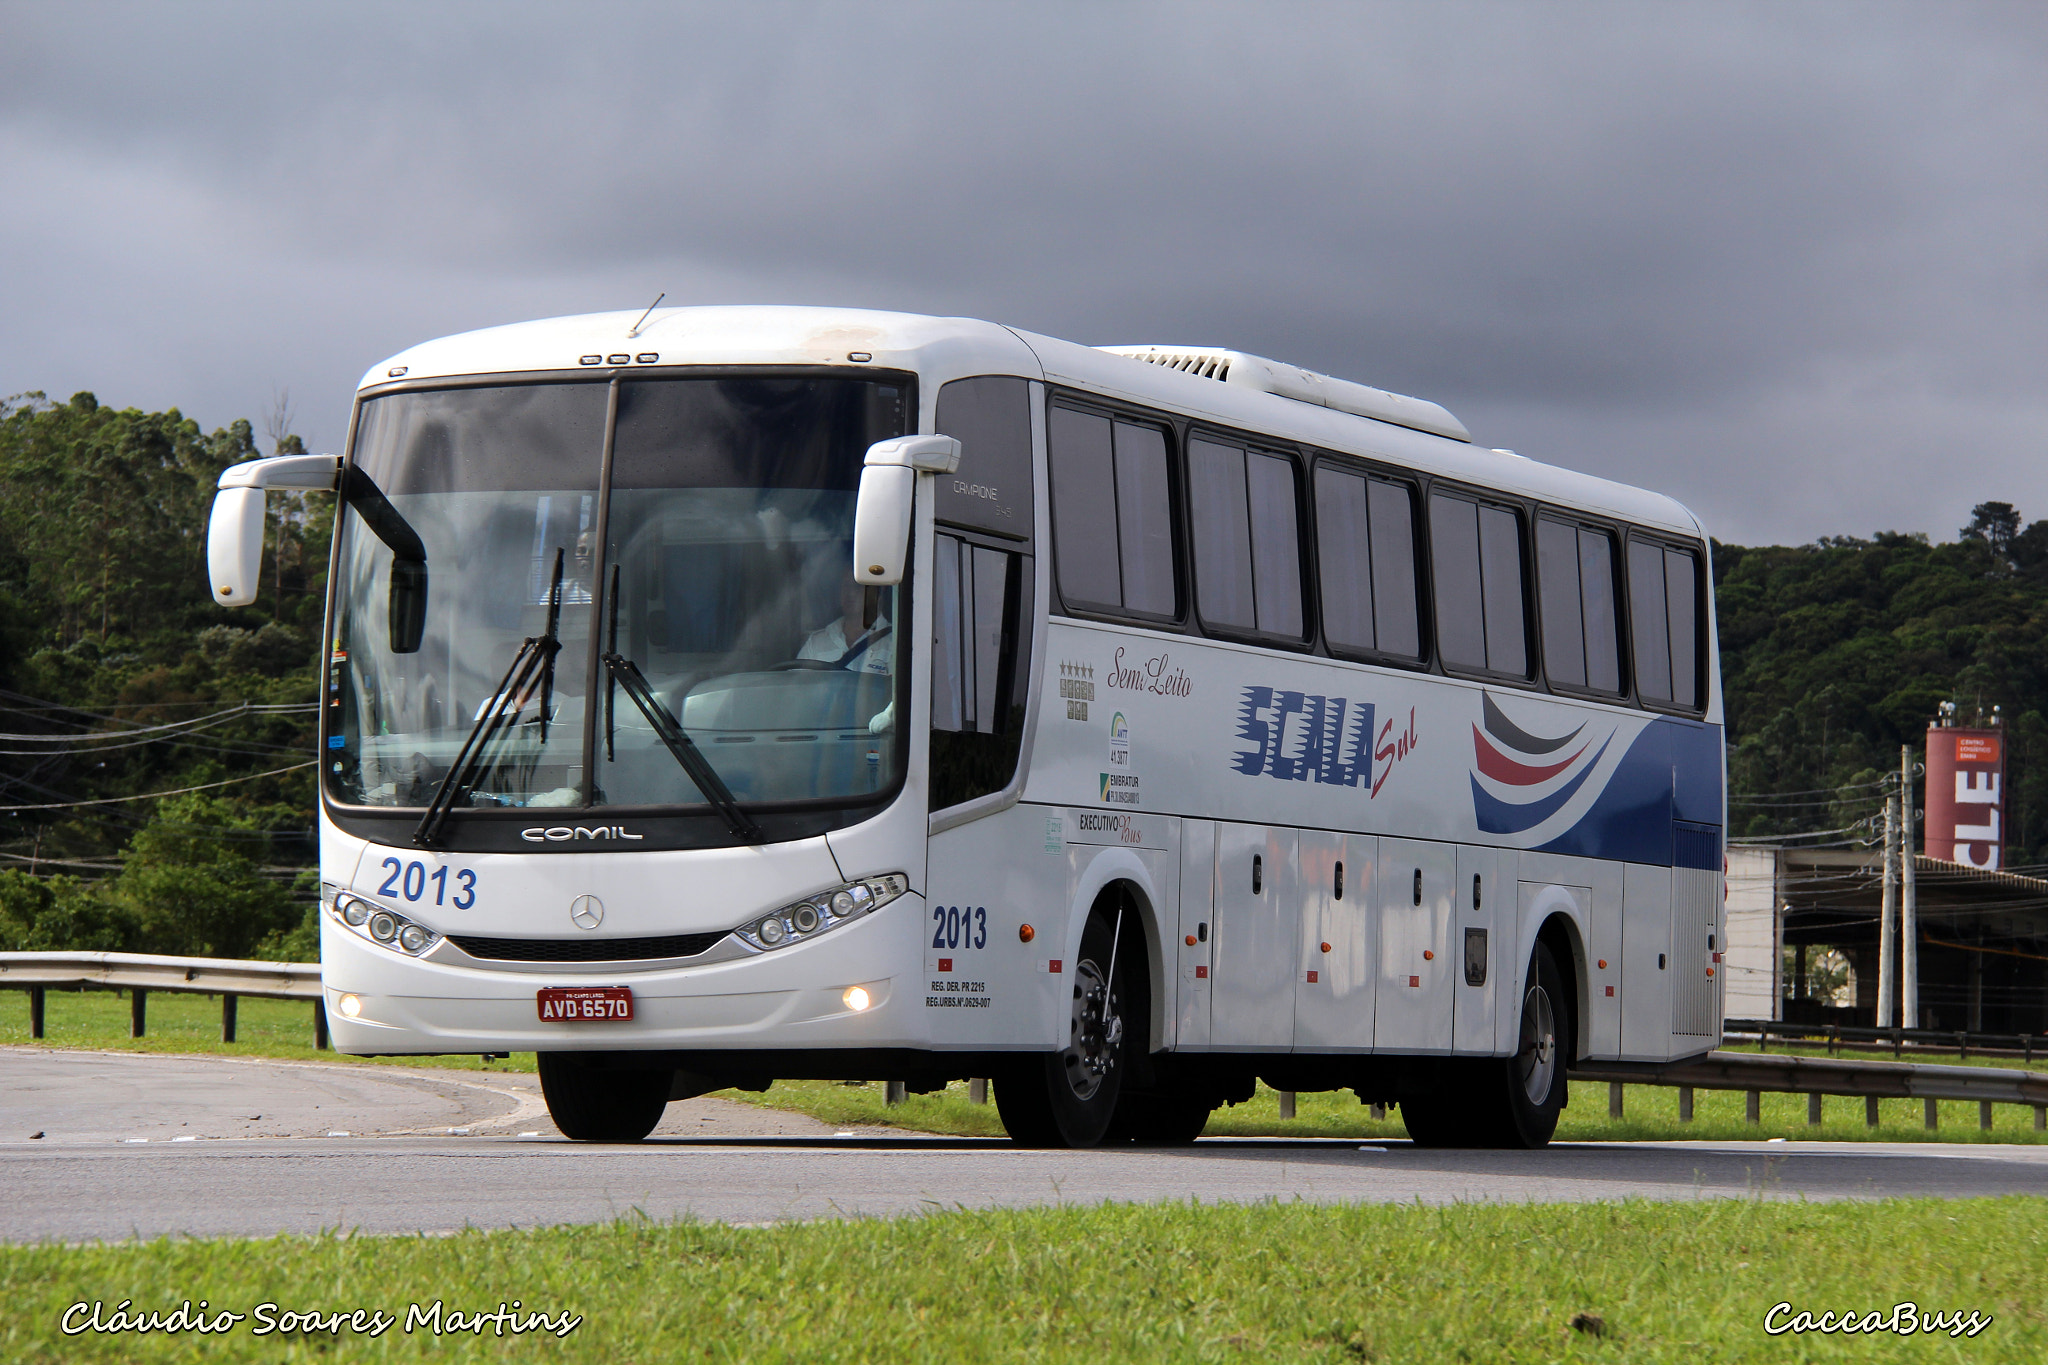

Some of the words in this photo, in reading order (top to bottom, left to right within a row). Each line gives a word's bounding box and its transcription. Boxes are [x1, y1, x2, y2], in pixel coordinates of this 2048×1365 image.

[953, 480, 998, 501] CAMPIONE
[1107, 646, 1148, 691] Semi
[1147, 653, 1193, 698] Leito
[1117, 729, 1128, 739] ANTT
[1230, 686, 1376, 789] SCALA
[1371, 705, 1418, 799] Sul
[1110, 775, 1139, 787] EMBRATUR
[1080, 815, 1119, 831] EXECUTIVO
[1953, 771, 2000, 872] CLE
[521, 826, 644, 842] COMIL
[377, 857, 477, 910] 2013
[932, 905, 987, 949] 2013
[931, 981, 946, 992] REG.
[962, 982, 970, 992] PR
[971, 982, 985, 993] 2215
